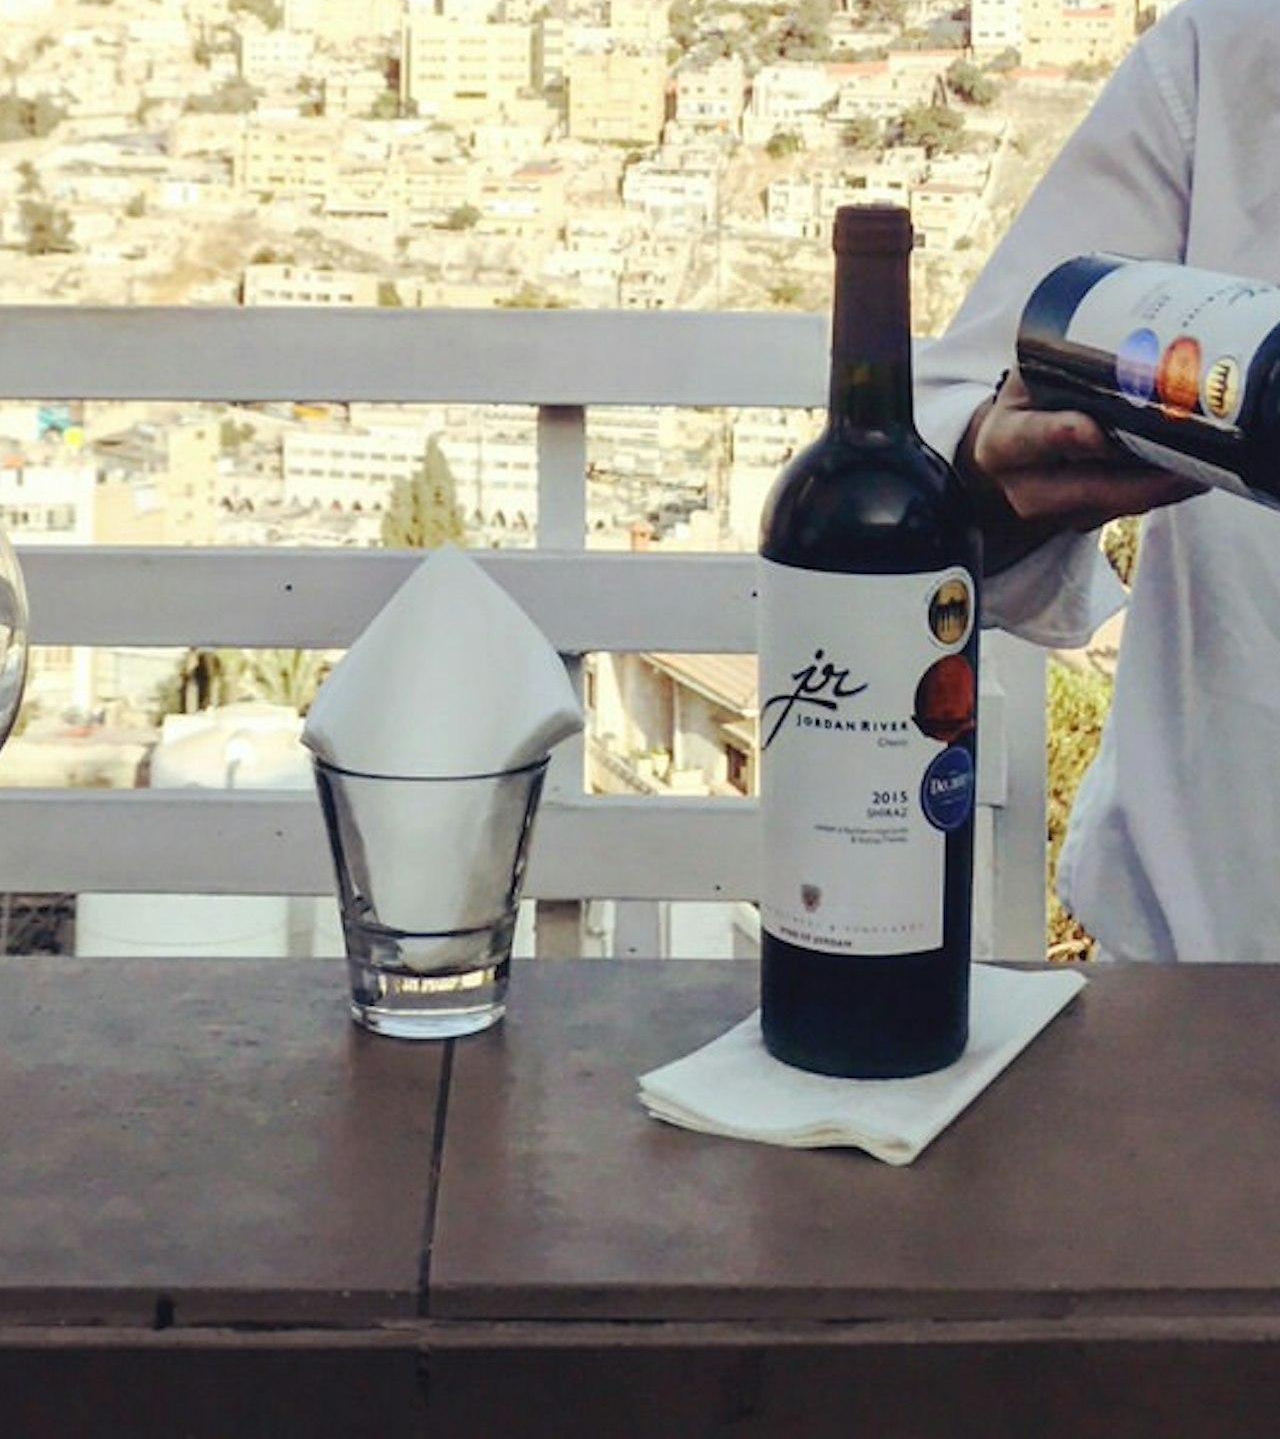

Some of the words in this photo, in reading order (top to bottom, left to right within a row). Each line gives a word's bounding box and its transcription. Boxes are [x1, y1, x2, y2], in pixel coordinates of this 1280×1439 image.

[796, 714, 856, 731] JORDAN
[861, 721, 908, 732] RIVER
[872, 790, 908, 805] 2015
